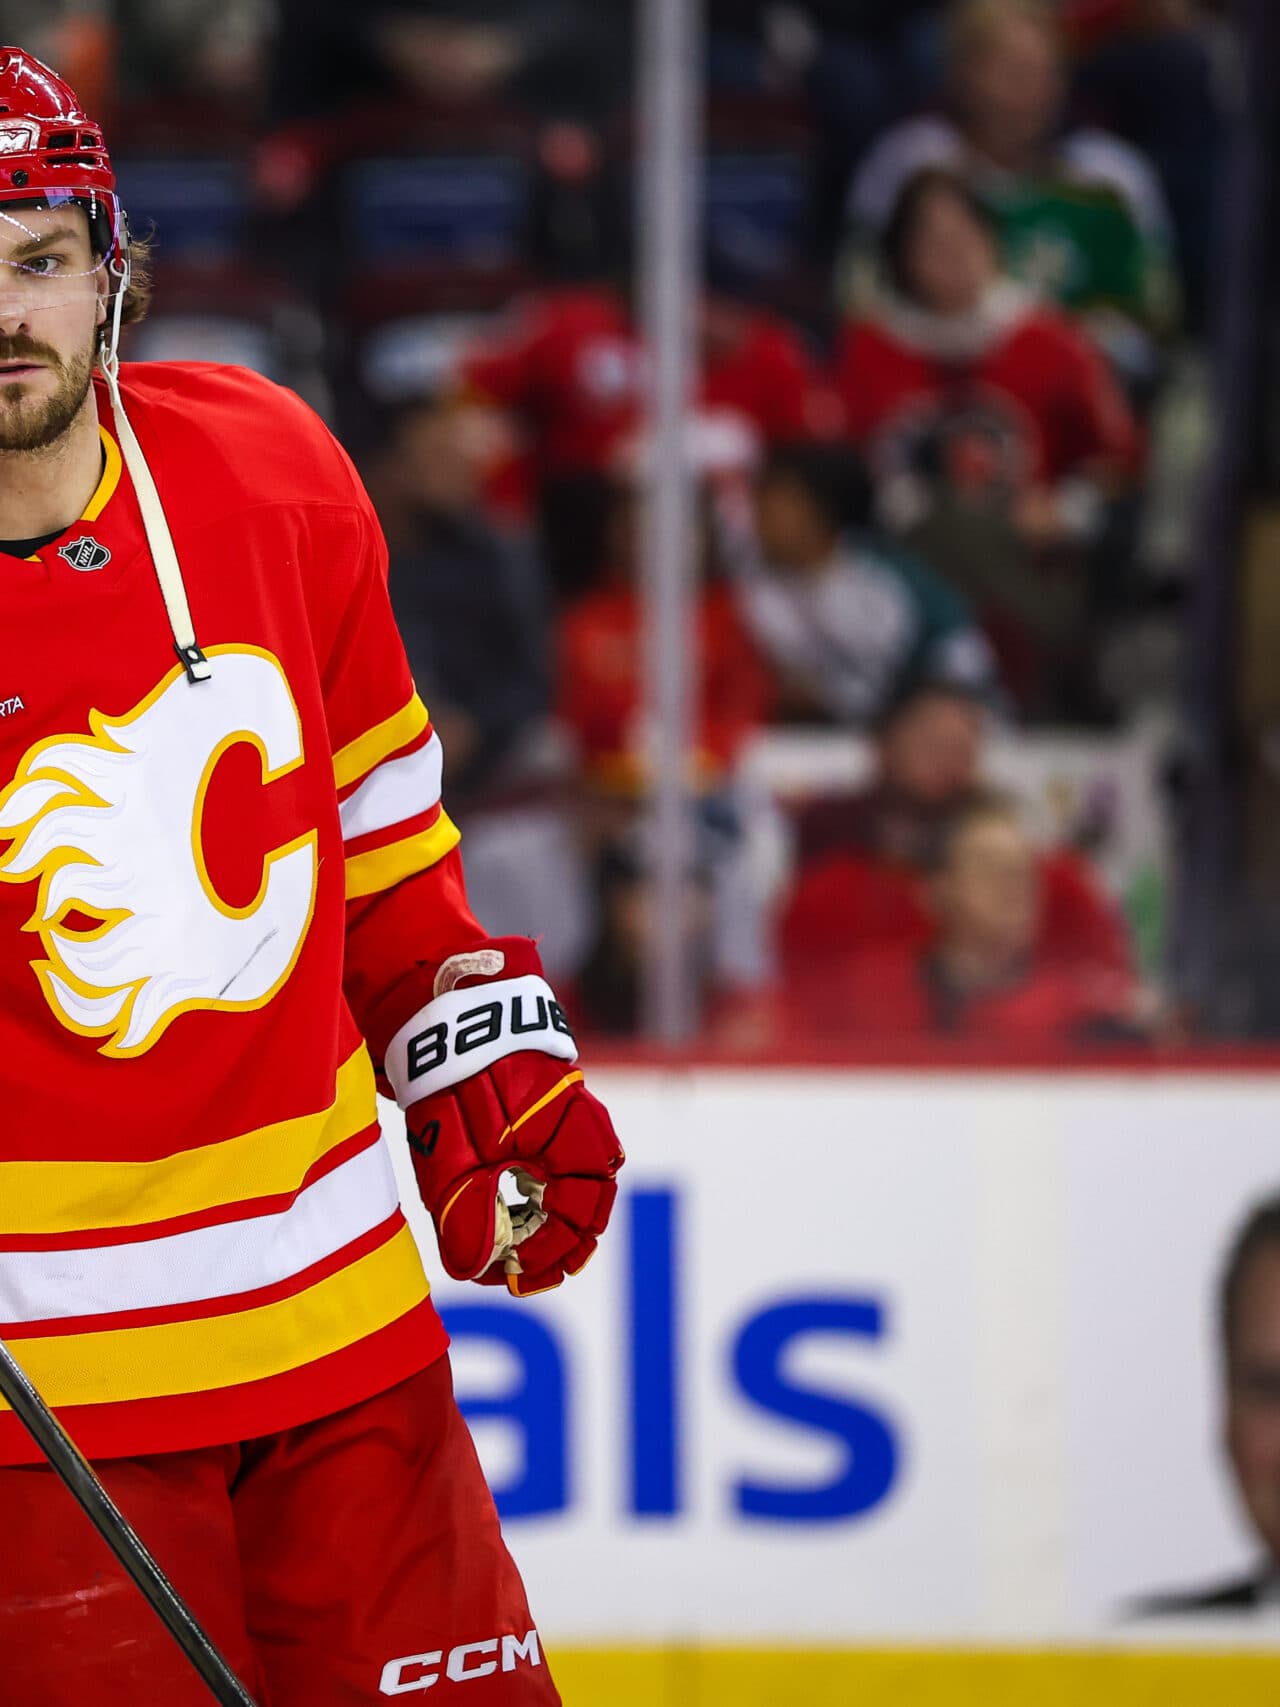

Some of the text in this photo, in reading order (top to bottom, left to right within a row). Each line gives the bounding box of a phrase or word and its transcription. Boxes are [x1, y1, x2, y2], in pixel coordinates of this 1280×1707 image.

[78, 545, 94, 566] NHL
[407, 995, 575, 1083] Baue
[378, 1628, 542, 1697] CCM
